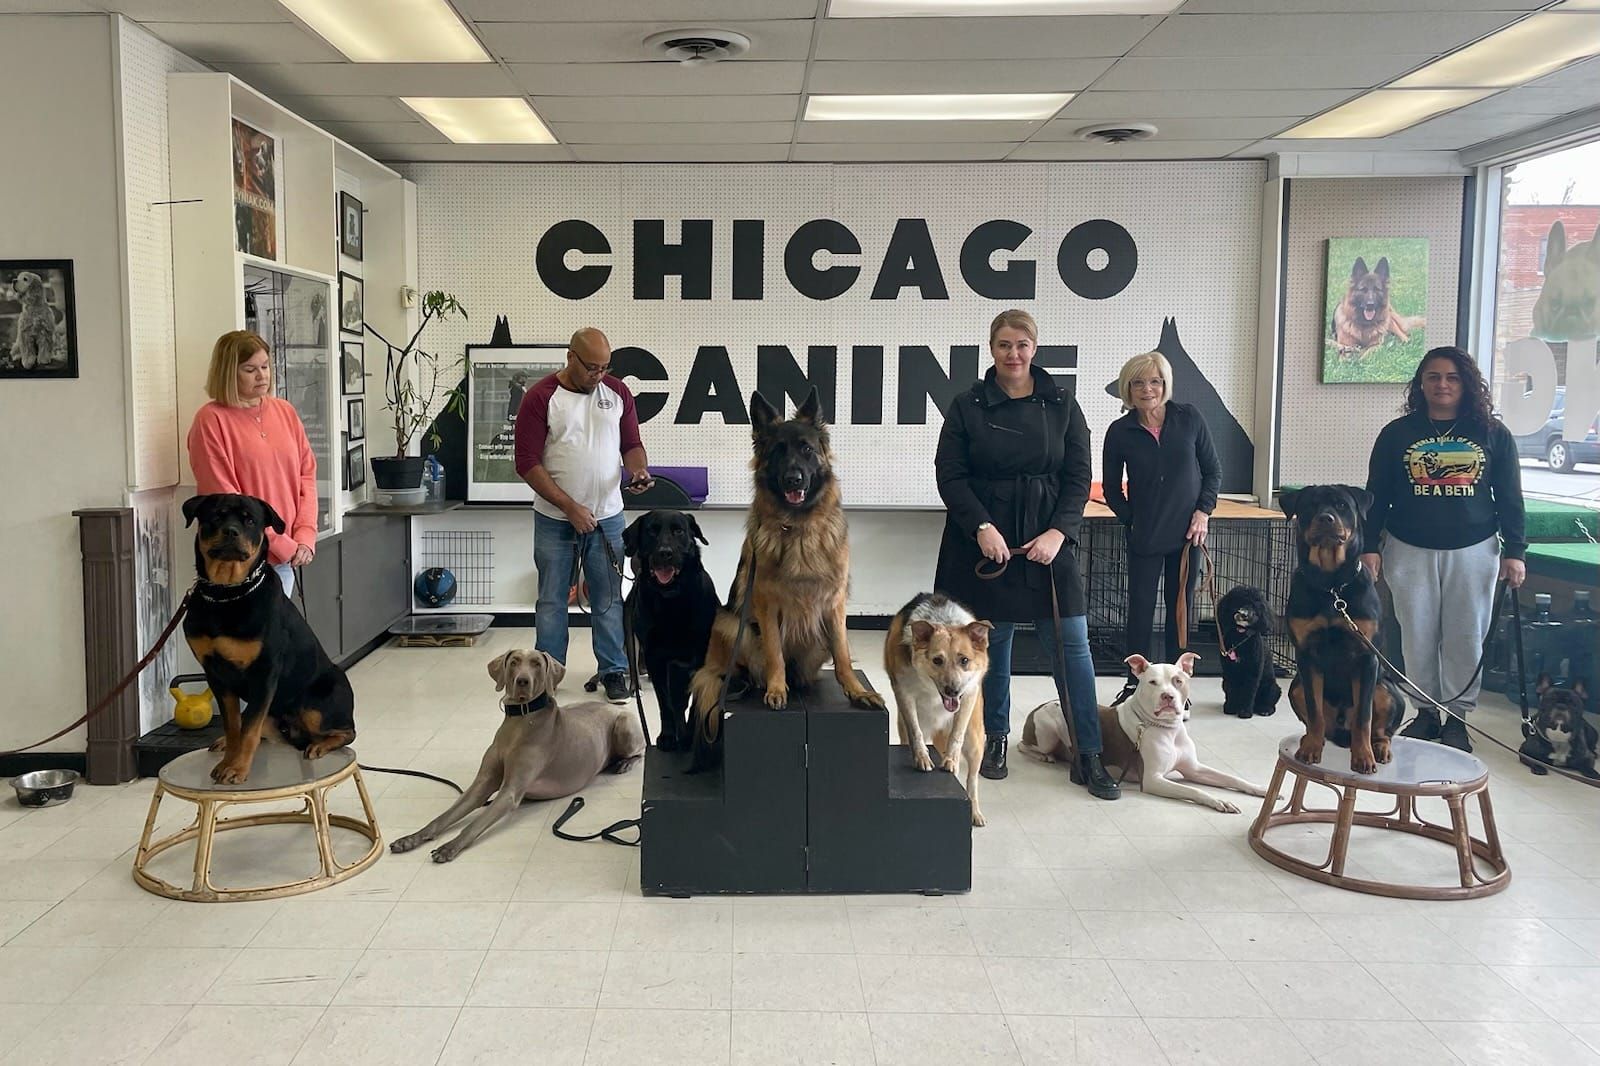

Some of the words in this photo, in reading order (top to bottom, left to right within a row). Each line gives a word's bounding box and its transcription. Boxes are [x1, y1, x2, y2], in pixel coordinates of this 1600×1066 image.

[536, 219, 1138, 301] CHICAGO
[1409, 437, 1435, 449] WORLD
[1414, 484, 1430, 496] BE
[1433, 484, 1442, 496] A
[1445, 484, 1474, 497] BETH
